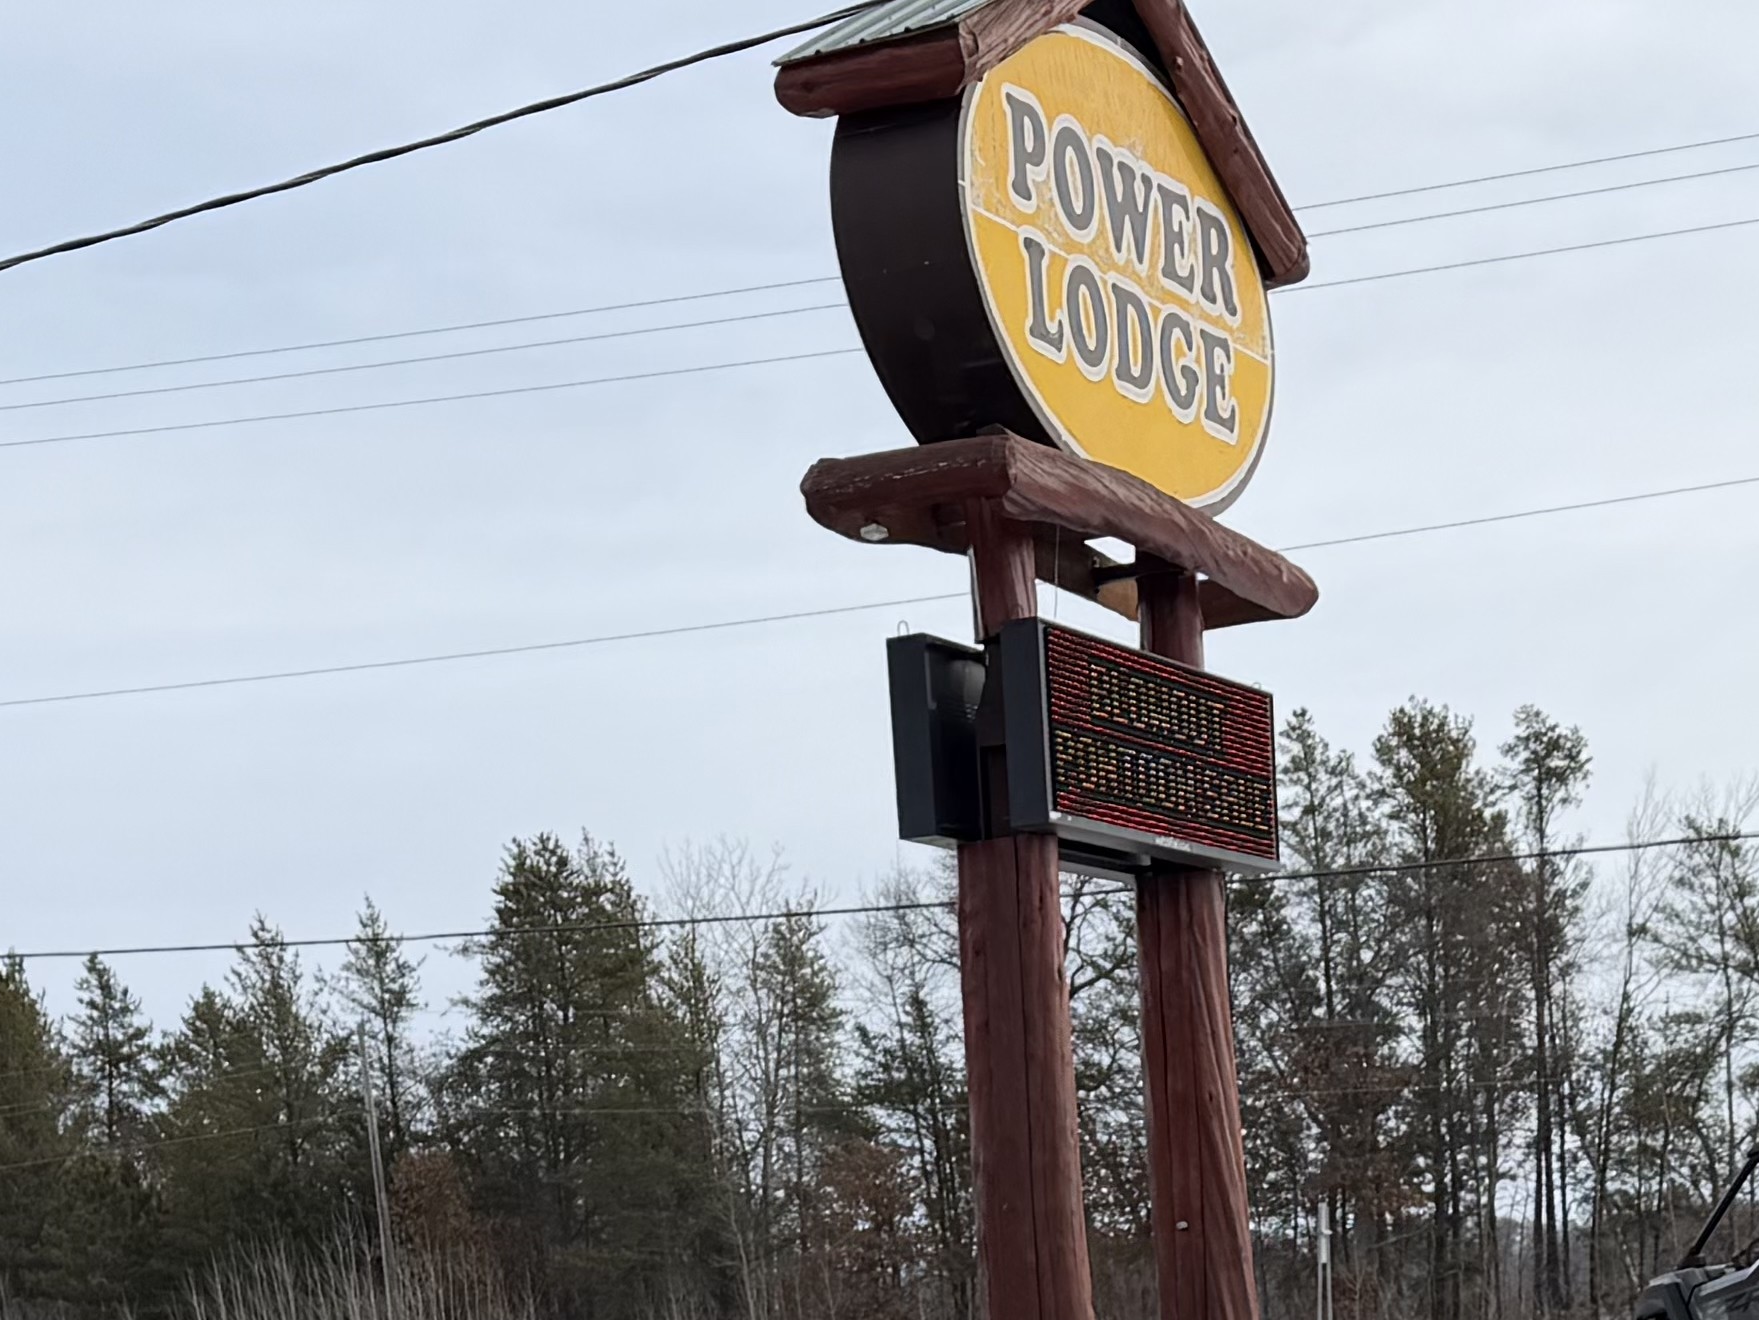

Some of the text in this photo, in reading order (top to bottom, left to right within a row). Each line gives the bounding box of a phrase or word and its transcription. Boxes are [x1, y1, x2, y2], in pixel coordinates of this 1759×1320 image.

[1002, 87, 1241, 322] POWER
[1021, 236, 1239, 436] LODGE
[1054, 728, 1269, 831] PONTOON SALE
[1089, 662, 1226, 752] BLOWOUT
